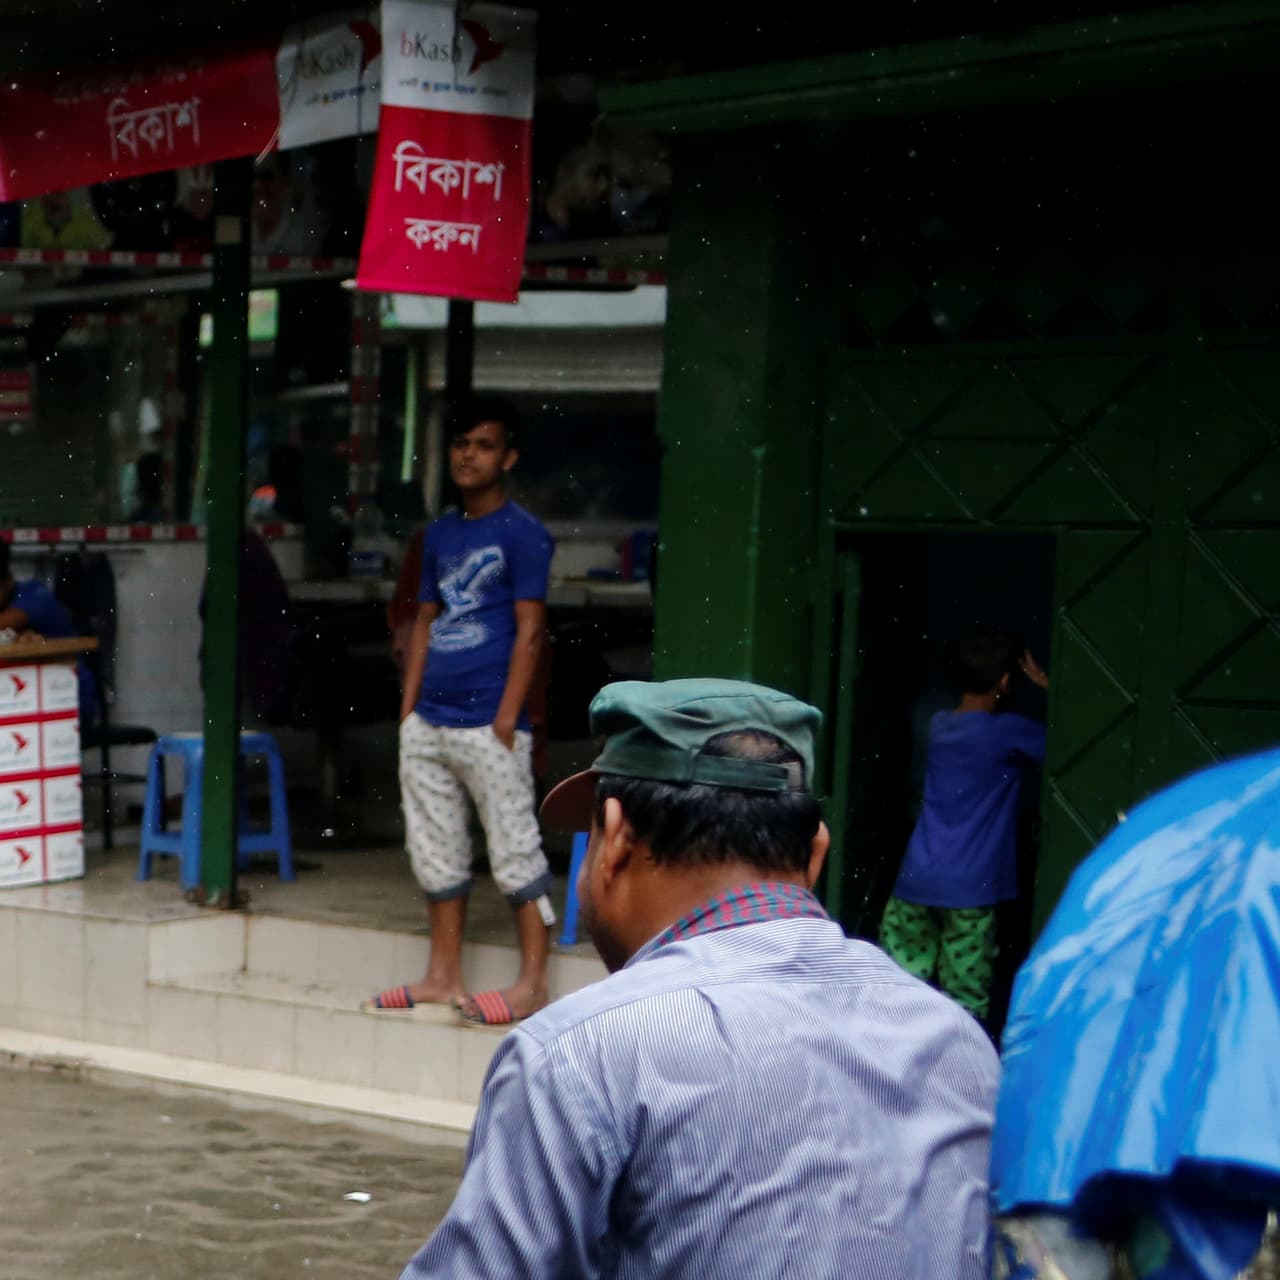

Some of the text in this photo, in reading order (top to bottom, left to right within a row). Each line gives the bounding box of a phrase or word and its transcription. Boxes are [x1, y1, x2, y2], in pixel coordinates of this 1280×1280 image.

[400, 31, 462, 64] bKash
[107, 97, 201, 160] বিকাশ
[392, 139, 506, 201] বিকাশ
[404, 217, 483, 255] করুন
